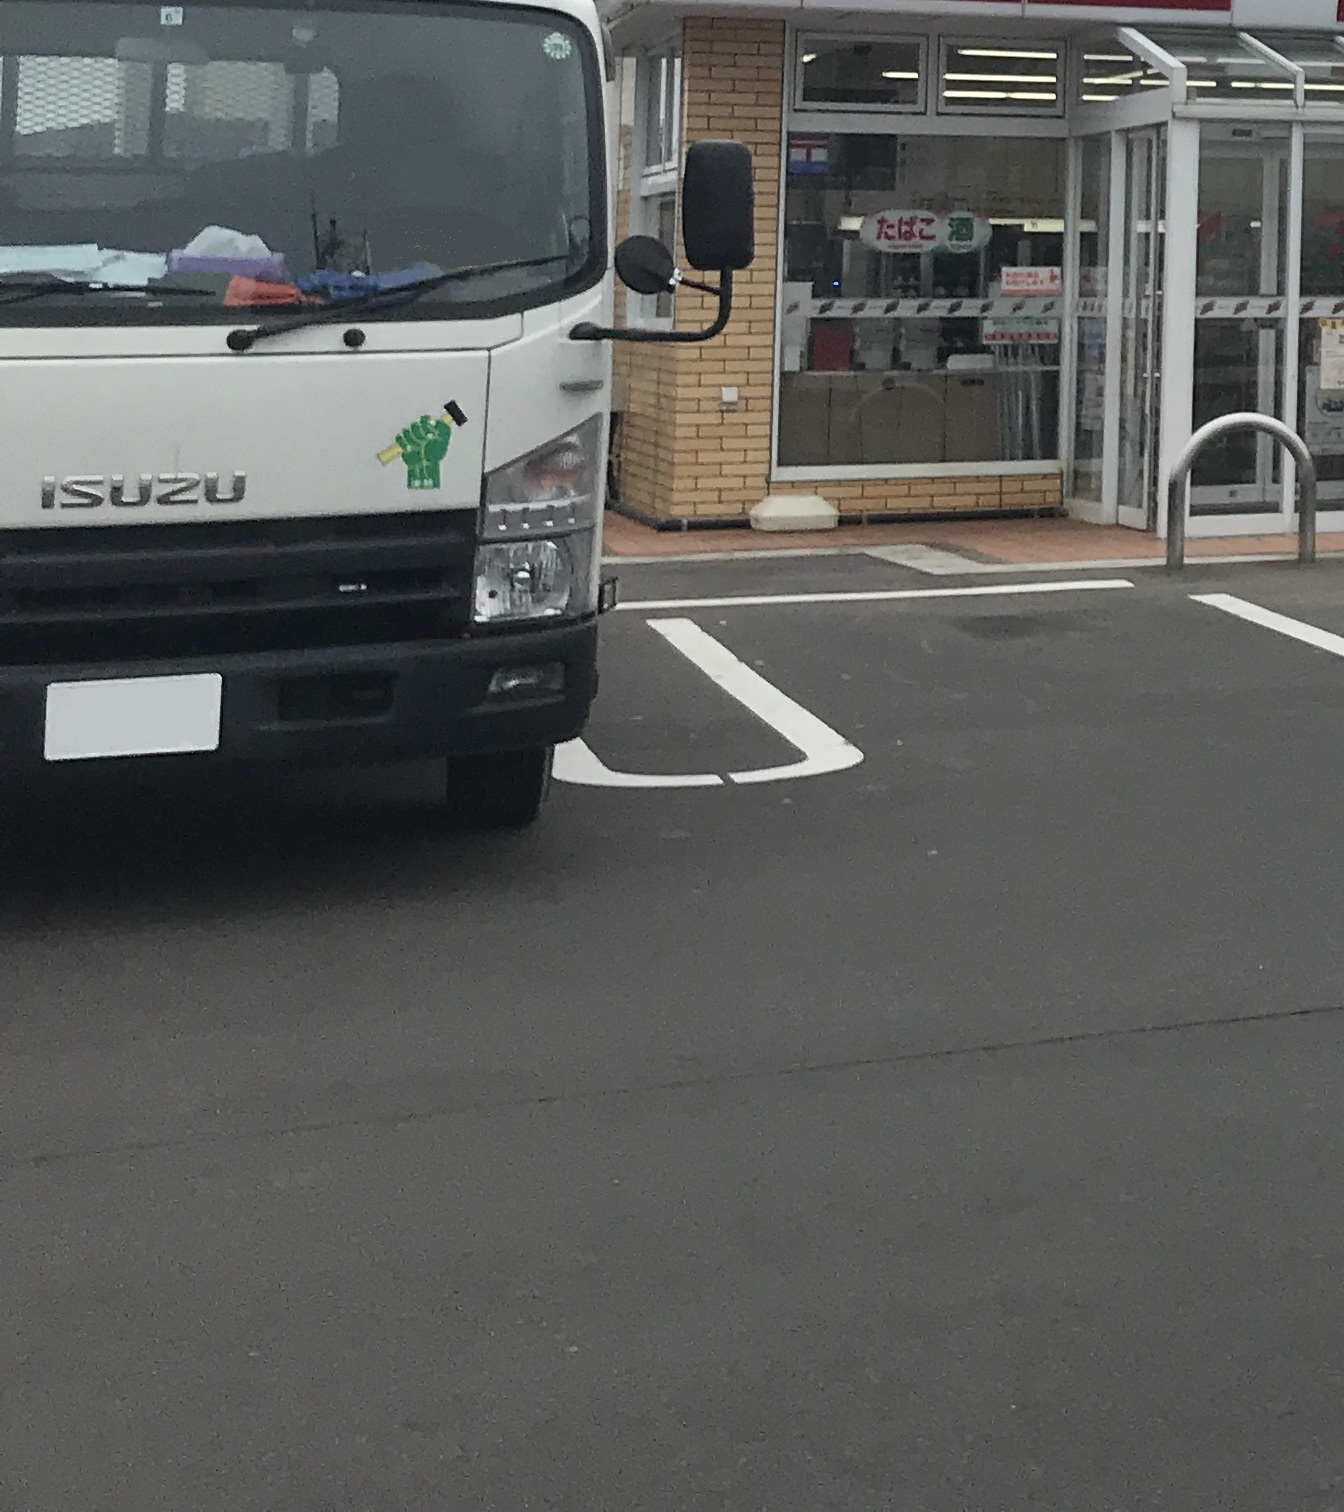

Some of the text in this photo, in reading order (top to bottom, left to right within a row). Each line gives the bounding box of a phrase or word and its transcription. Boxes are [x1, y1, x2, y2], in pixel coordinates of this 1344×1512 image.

[876, 217, 936, 241] たばこ
[41, 470, 246, 510] ISUZU
